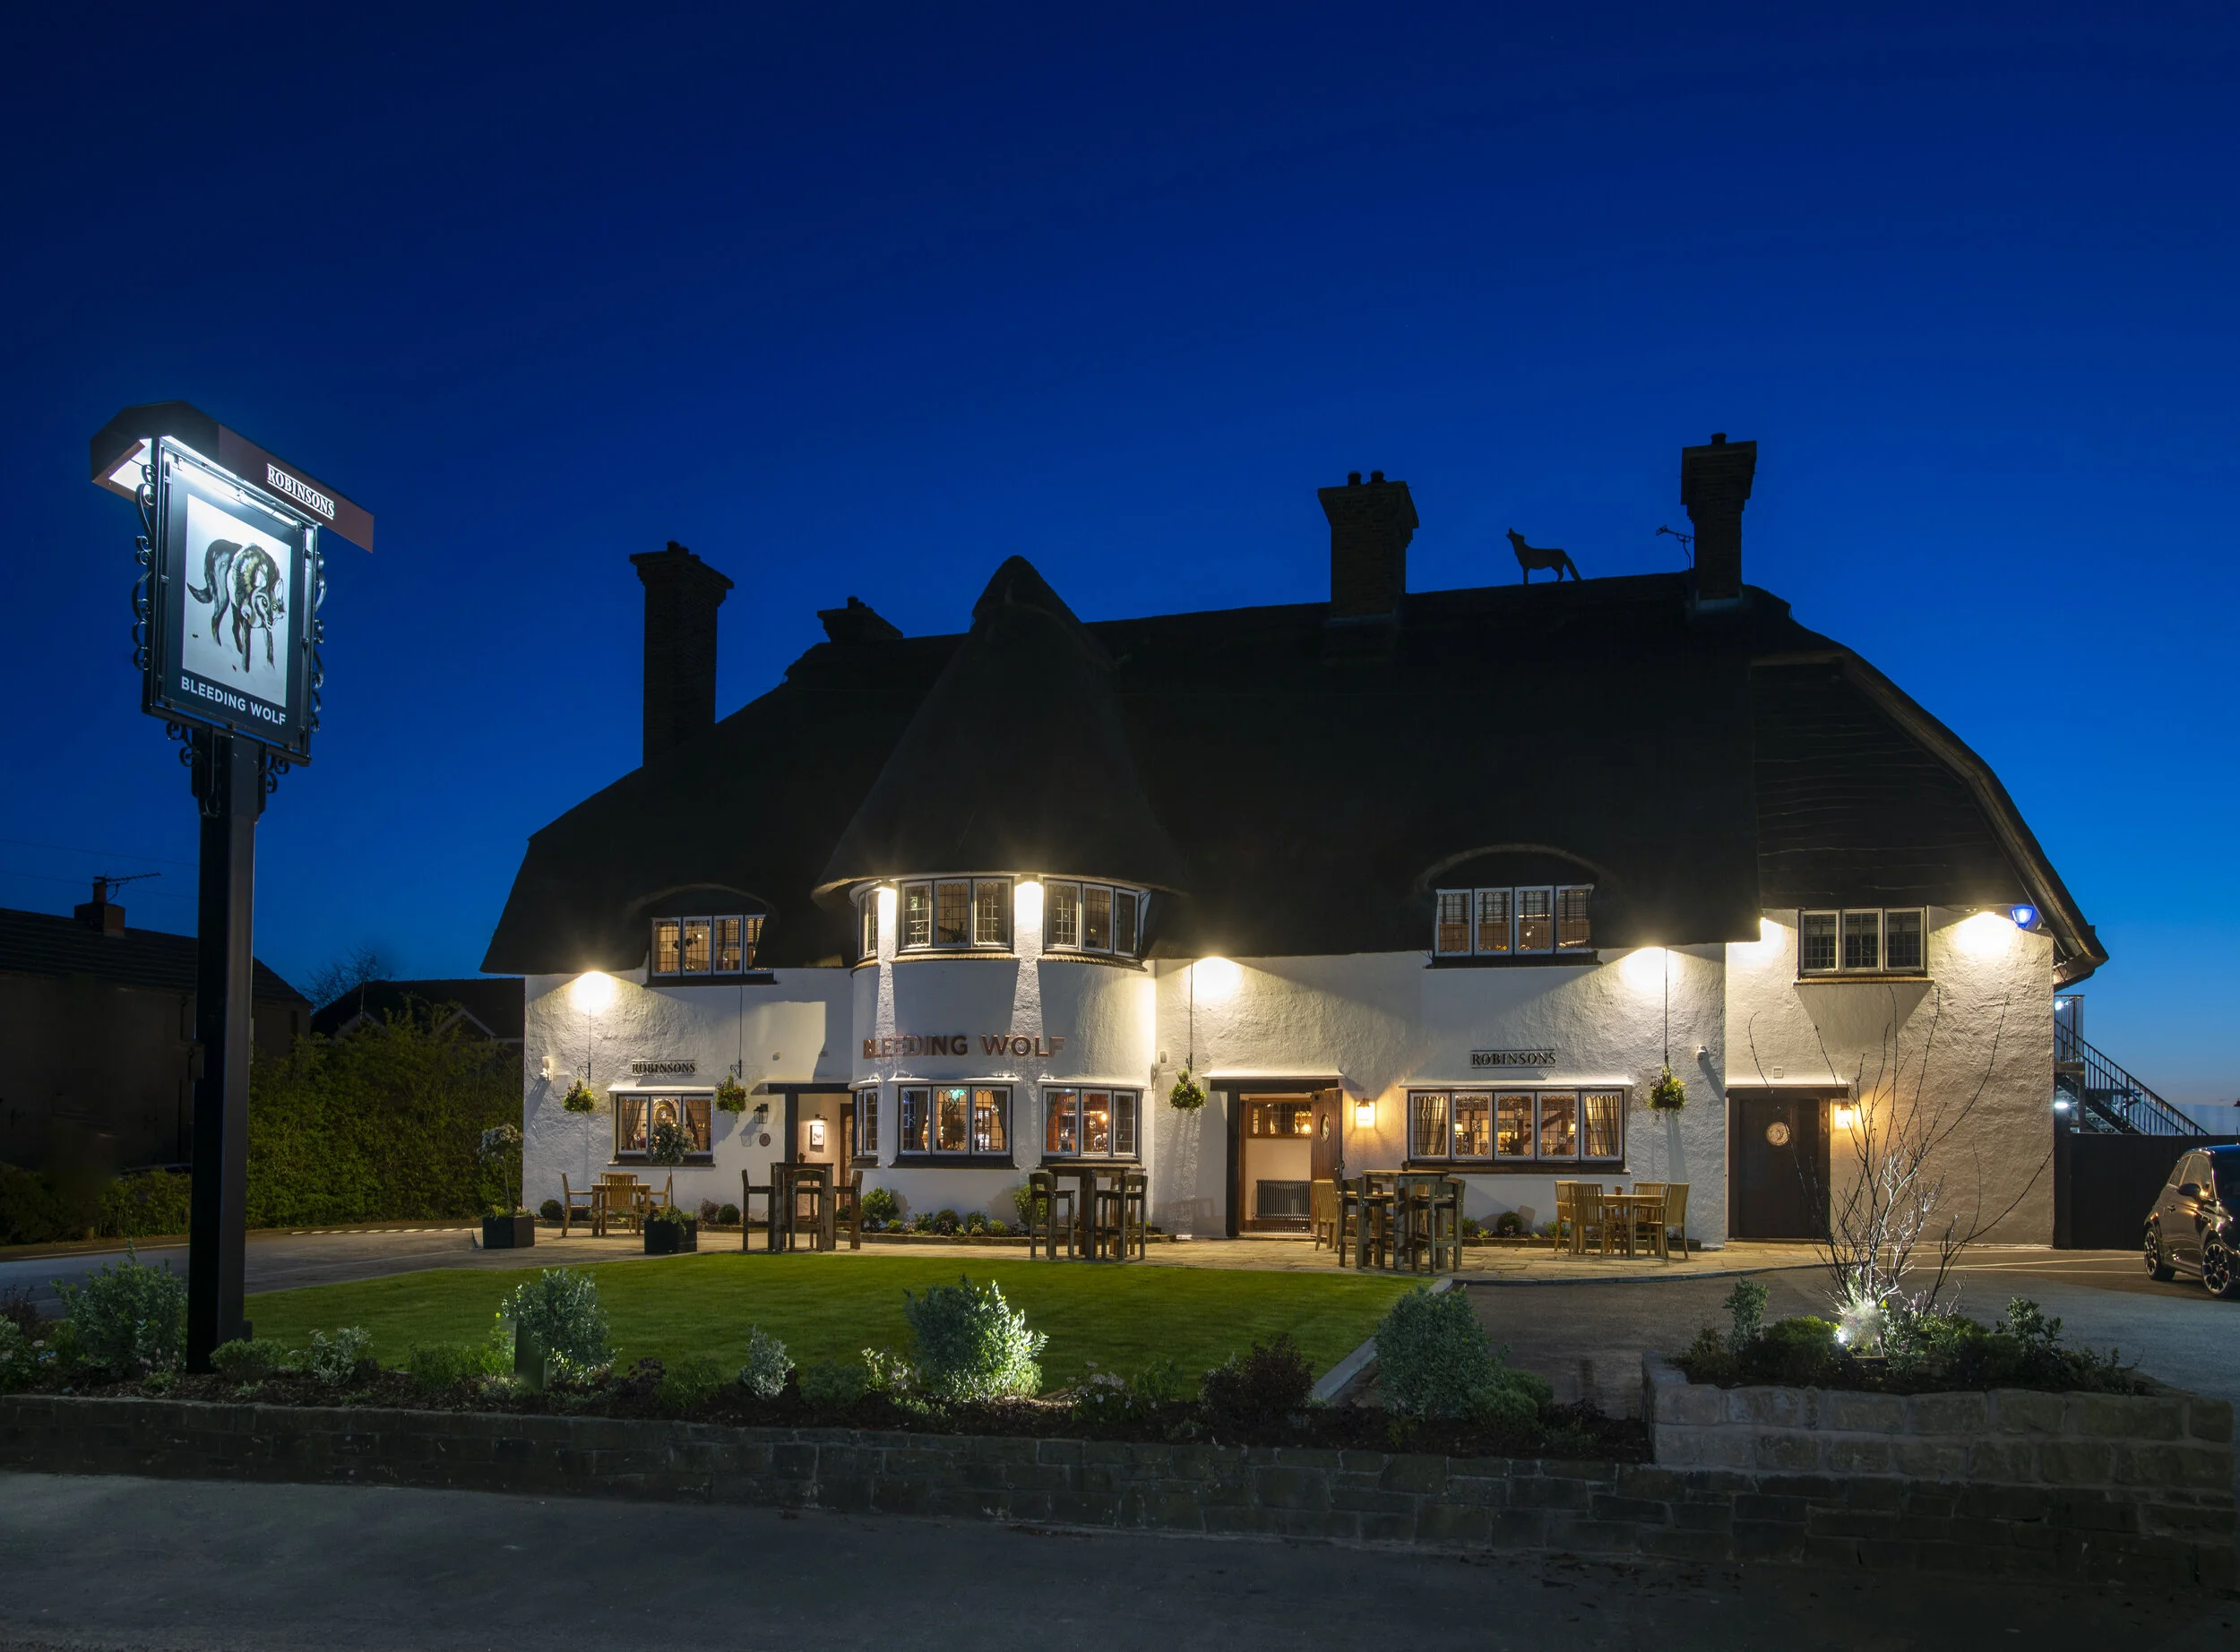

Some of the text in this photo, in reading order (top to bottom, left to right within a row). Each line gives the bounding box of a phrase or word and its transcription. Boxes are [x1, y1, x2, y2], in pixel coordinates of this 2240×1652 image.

[267, 466, 335, 517] ROBINSONS
[181, 675, 287, 726] BLEEDING WOLF
[863, 1034, 1066, 1059] BLEEDING WOLF
[1471, 1053, 1556, 1065] ROBINSONS
[632, 1062, 695, 1073] ROBINSONS
